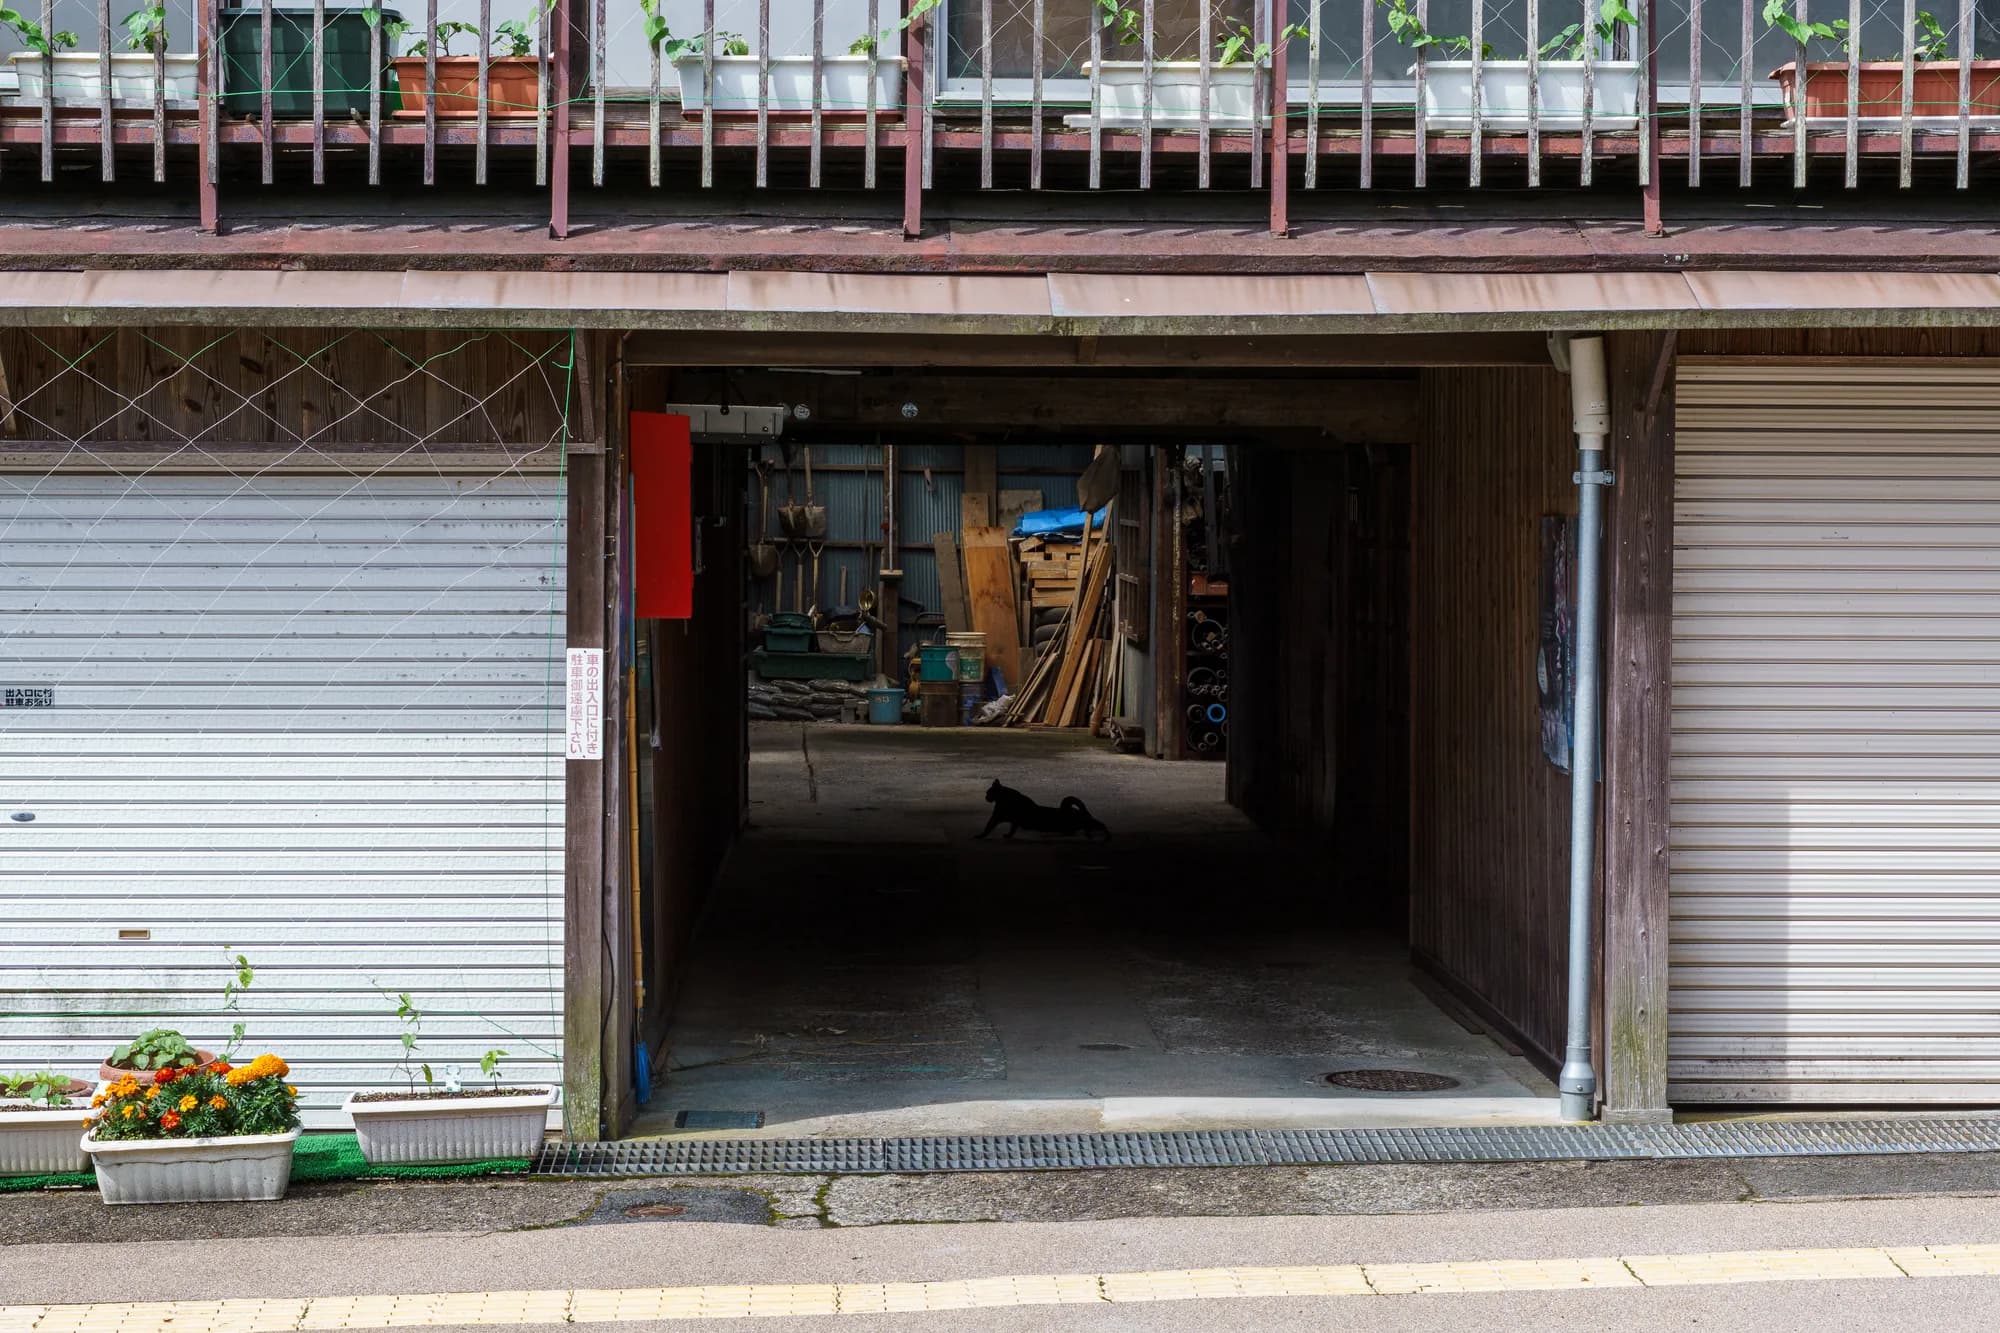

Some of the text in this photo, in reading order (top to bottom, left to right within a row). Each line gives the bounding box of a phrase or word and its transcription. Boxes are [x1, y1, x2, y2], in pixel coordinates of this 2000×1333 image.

[5, 689, 52, 697] 出入口に付
[570, 653, 584, 754] 駐車御遠慮下さい
[586, 654, 599, 755] 車の出入口に付き
